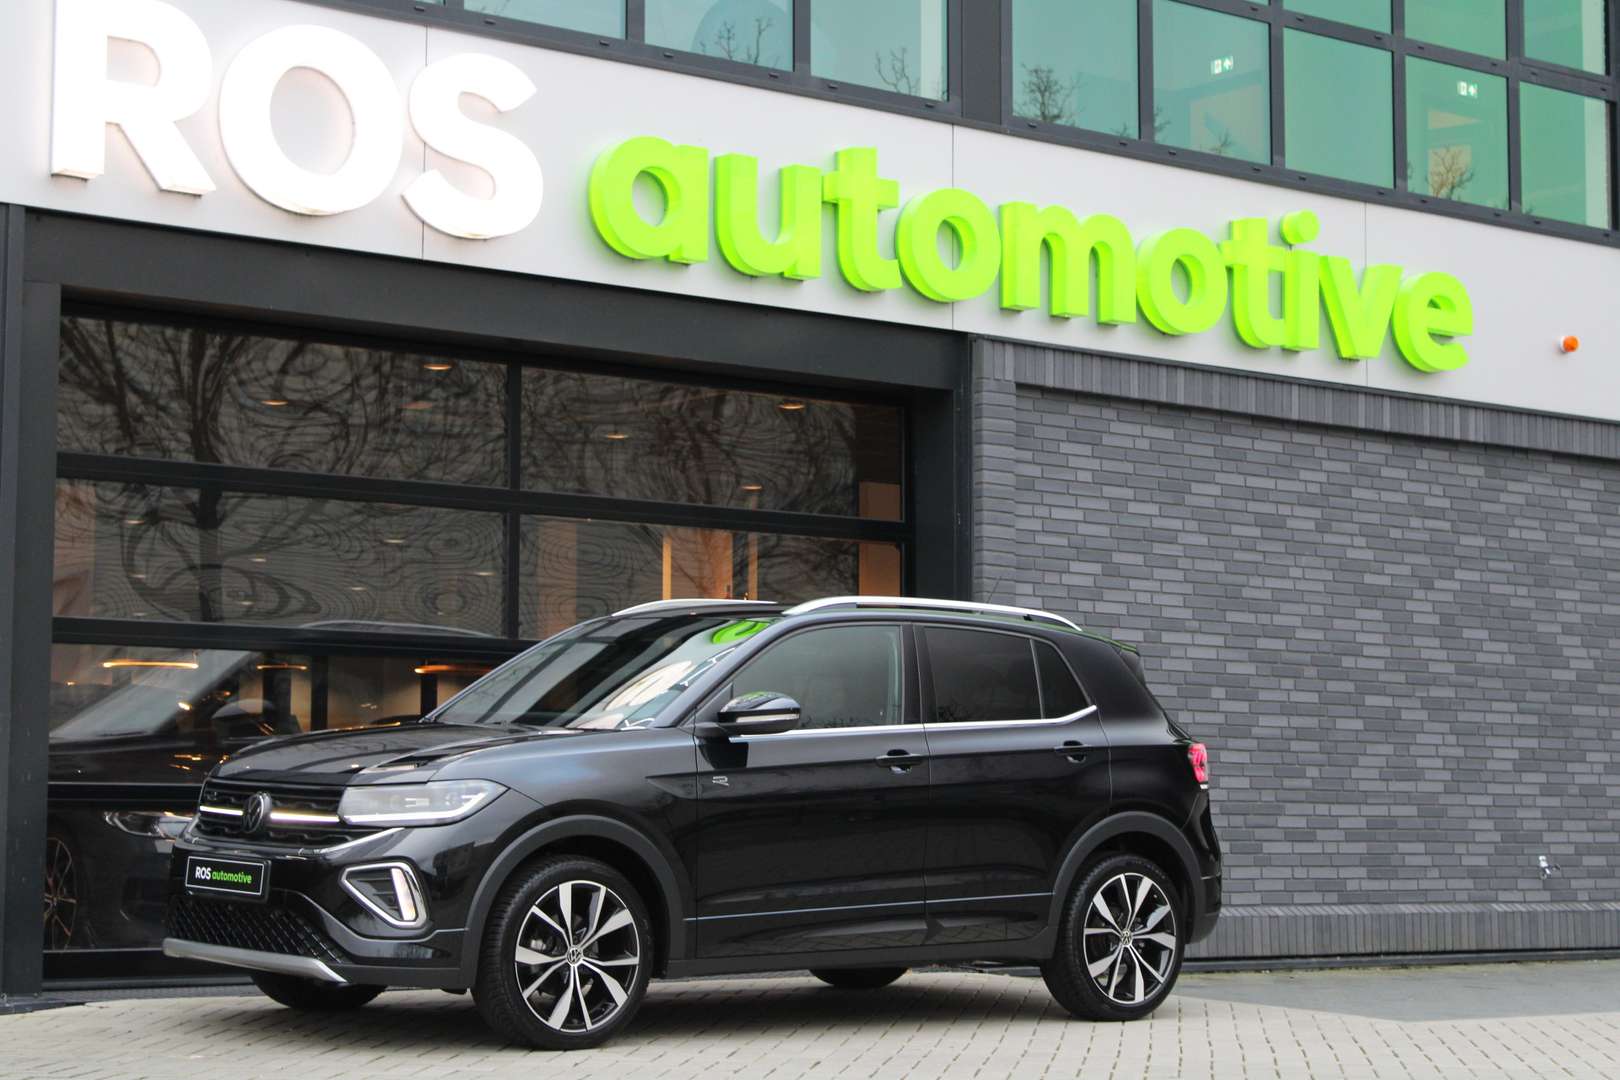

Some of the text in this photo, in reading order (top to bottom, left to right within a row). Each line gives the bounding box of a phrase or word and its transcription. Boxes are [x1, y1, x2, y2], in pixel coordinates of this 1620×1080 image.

[50, 0, 1473, 373] ROS automotive
[195, 866, 252, 884] ROS automotive
